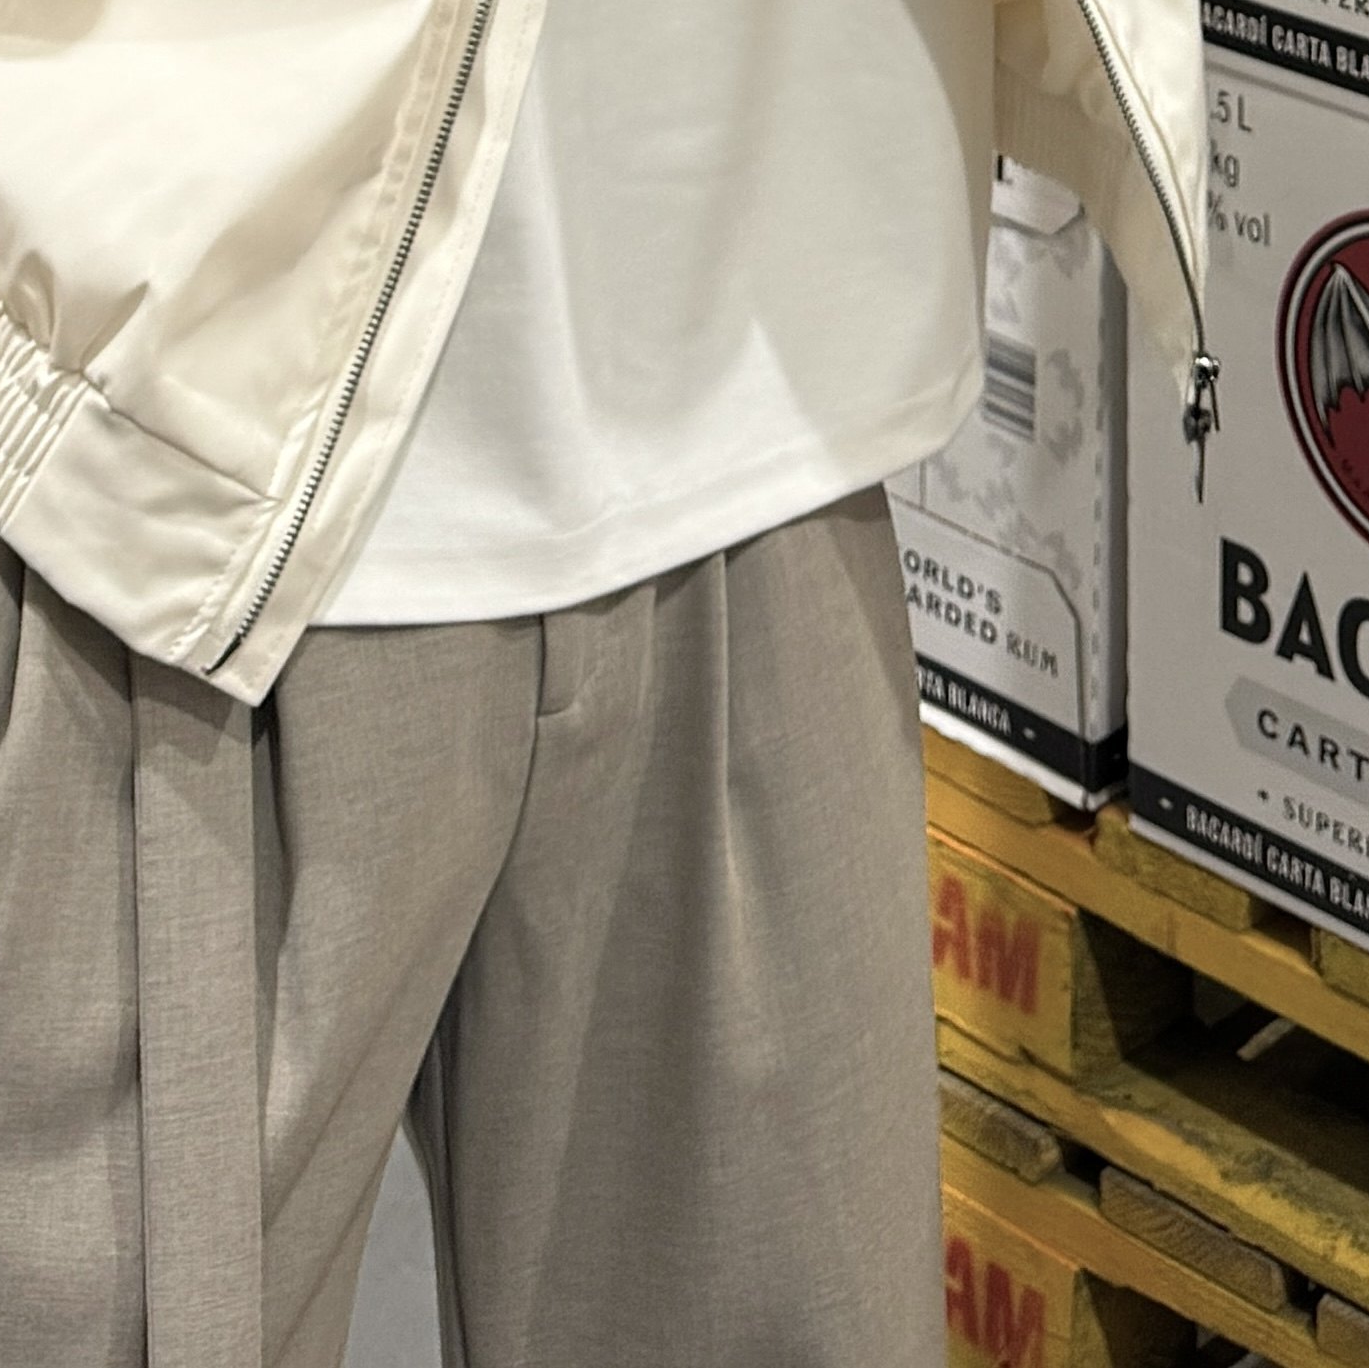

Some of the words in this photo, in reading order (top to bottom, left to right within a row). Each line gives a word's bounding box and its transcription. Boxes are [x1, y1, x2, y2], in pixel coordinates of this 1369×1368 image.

[1273, 17, 1332, 67] CARTA
[1006, 629, 1058, 677] RUM
[1186, 804, 1264, 864] BACARDÍ
[1267, 844, 1326, 899] CARTA
